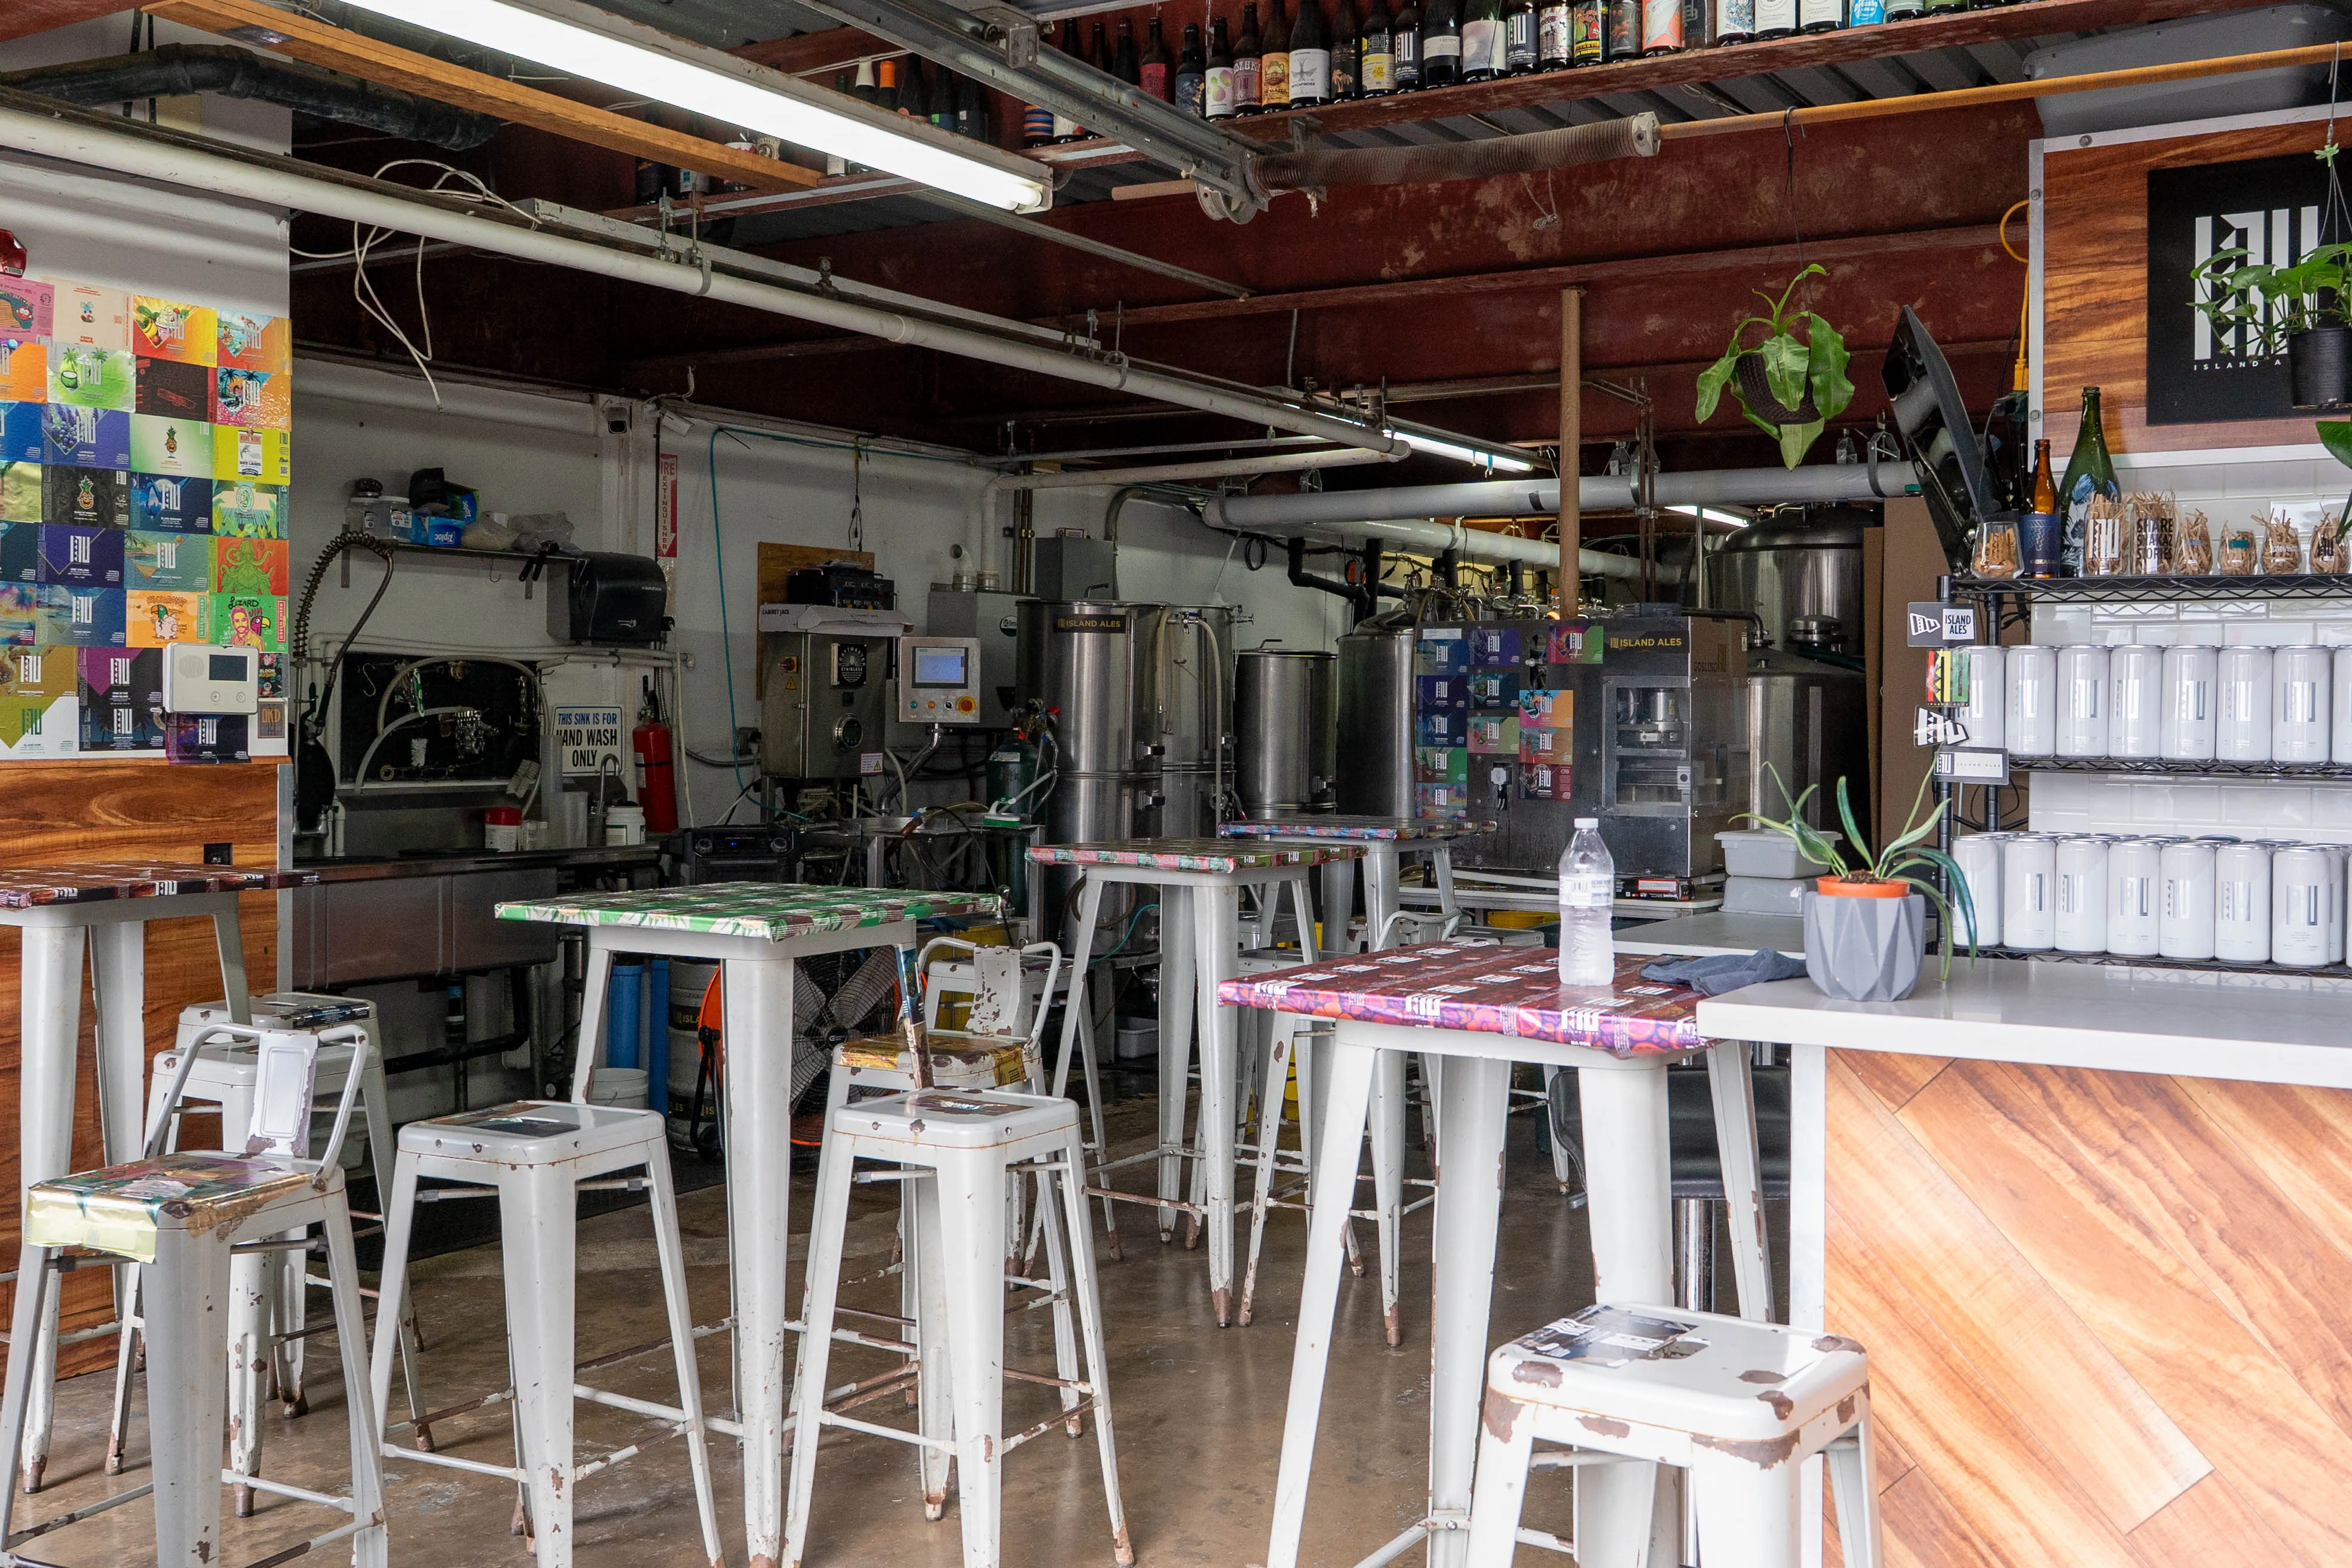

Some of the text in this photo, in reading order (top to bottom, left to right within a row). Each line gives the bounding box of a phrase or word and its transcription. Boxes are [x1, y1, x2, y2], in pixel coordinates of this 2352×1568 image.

[2194, 360, 2259, 372] ISLAND
[660, 462, 676, 476] IRE
[464, 499, 473, 519] Ziploc
[2137, 517, 2173, 533] SHARE
[434, 531, 455, 543] Ziploc
[2137, 547, 2173, 560] STORIES
[1945, 614, 1971, 625] ISLAND
[1949, 624, 1967, 635] ALES
[1620, 638, 1655, 647] ISLAND
[1658, 638, 1682, 647] ALES
[558, 713, 617, 725] THIS SINK IS FOR
[587, 729, 617, 746] WASH
[572, 749, 598, 767] ONLY
[683, 1015, 700, 1024] ISLA
